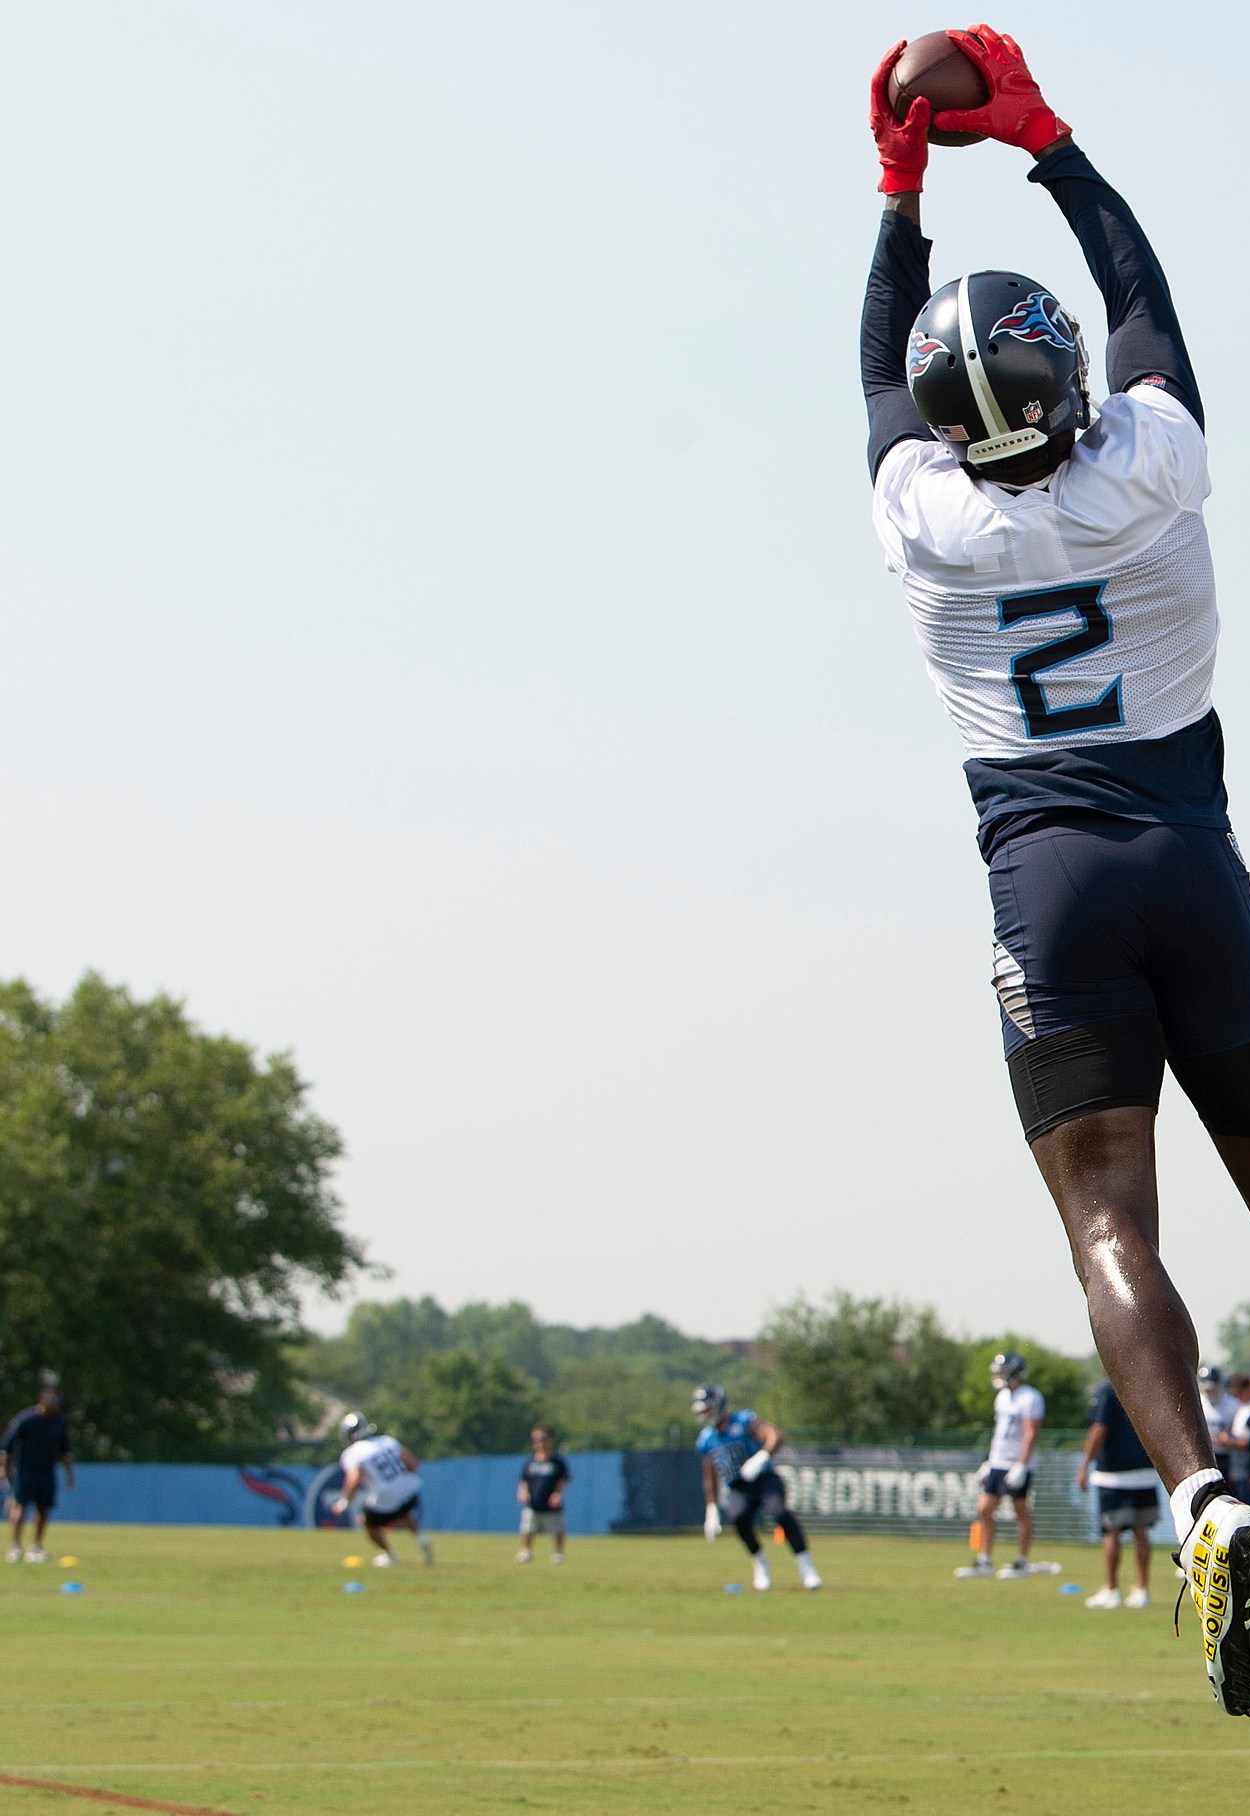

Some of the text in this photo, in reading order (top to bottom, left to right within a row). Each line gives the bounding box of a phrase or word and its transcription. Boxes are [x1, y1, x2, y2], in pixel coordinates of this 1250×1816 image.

[975, 433, 1037, 456] TENNESSEE
[1027, 410, 1041, 421] NFL
[996, 579, 1126, 740] 2
[1204, 1547, 1230, 1658] HOUSE
